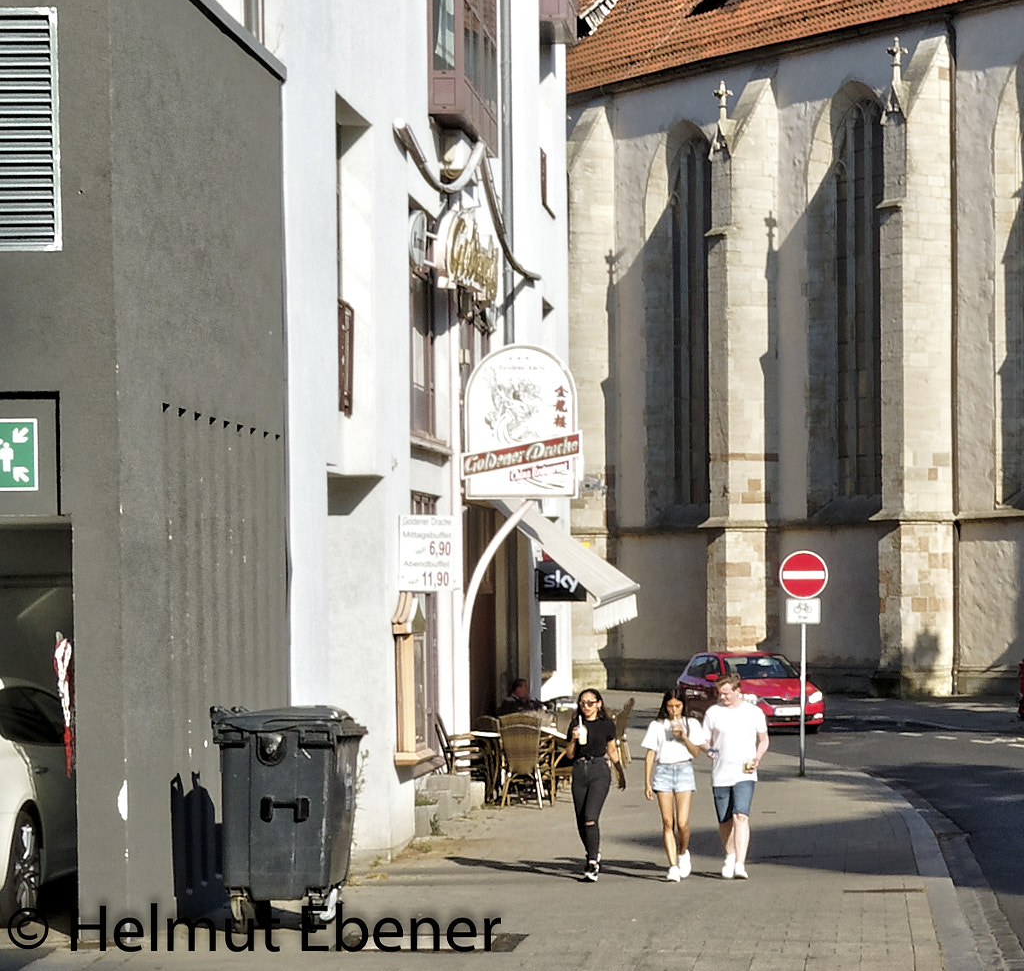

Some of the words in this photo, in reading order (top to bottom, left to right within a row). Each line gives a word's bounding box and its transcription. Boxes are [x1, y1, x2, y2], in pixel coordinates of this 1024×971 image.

[429, 540, 451, 558] 6,90
[422, 571, 450, 589] 11,90
[543, 569, 579, 594] sky
